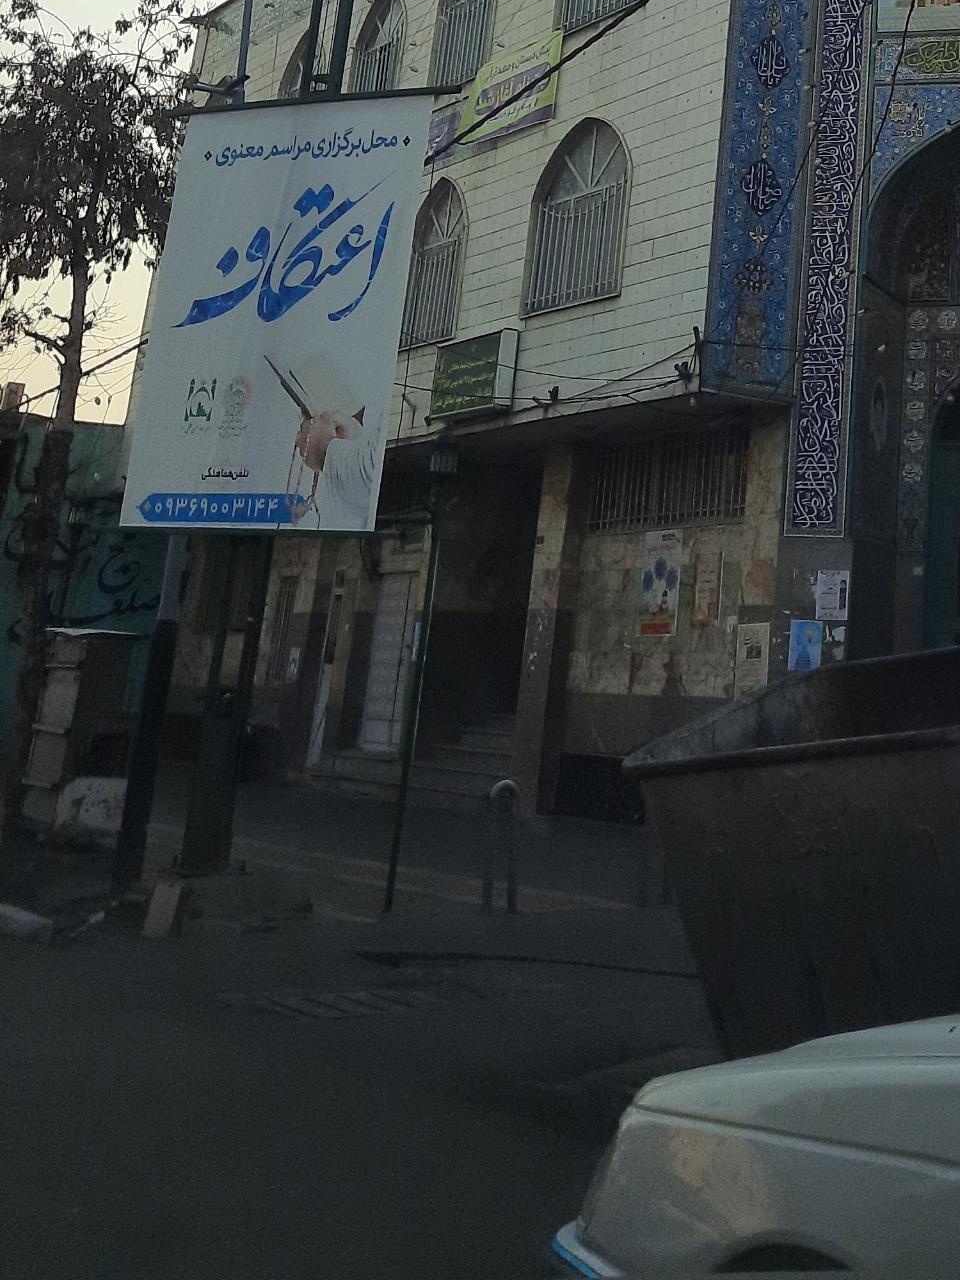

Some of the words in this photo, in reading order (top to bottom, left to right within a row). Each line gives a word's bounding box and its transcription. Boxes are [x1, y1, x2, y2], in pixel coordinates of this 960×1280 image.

[263, 135, 312, 161] مراسم
[312, 126, 362, 158] برگزاری
[362, 128, 398, 154] محل
[215, 143, 264, 167] معنوی
[172, 170, 398, 328] اعتکاف
[154, 497, 280, 518] ۰۹۳۶۹۰۰۳۱۴۴
